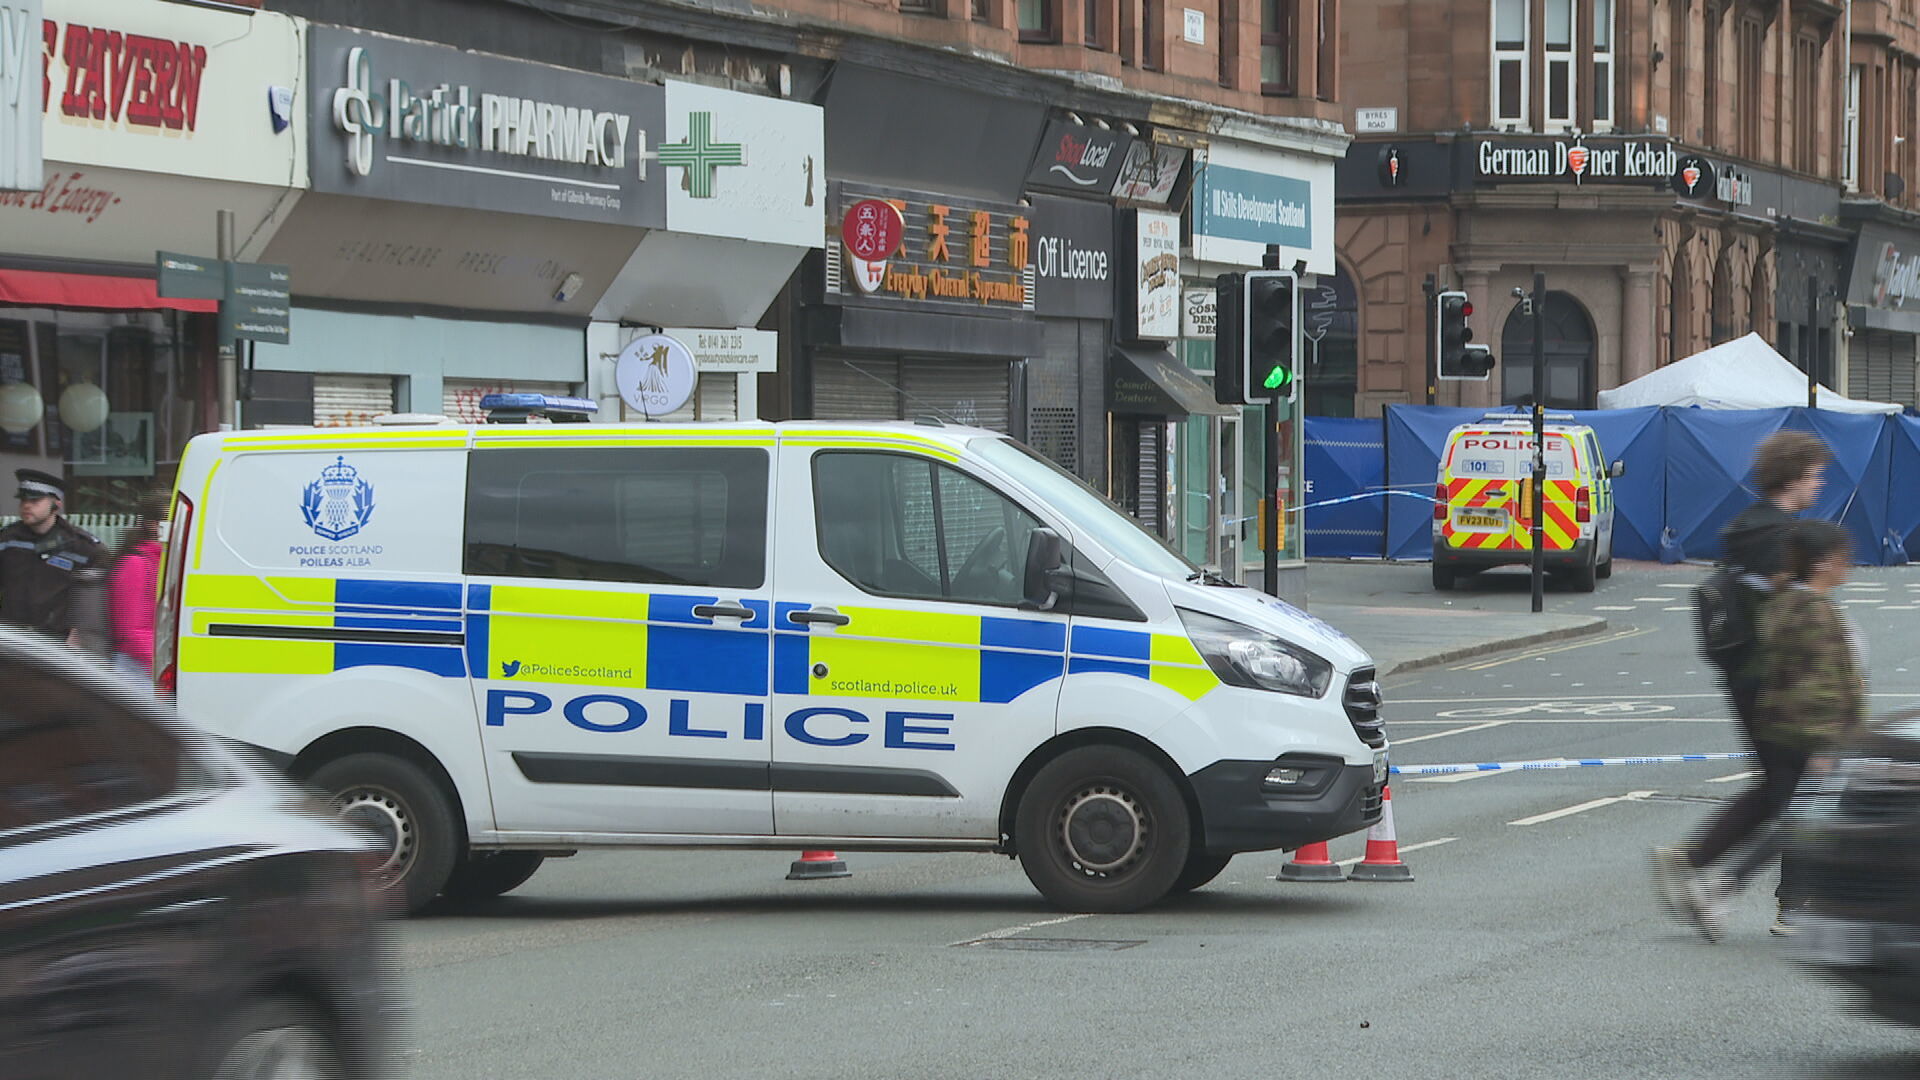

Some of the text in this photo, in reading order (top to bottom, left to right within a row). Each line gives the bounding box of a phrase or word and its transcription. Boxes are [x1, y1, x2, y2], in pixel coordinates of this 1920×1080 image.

[62, 23, 207, 132] TAVERN
[1366, 111, 1388, 119] BYRES
[481, 93, 630, 168] PHARMACY
[1368, 121, 1386, 129] ROAD
[1480, 141, 1549, 176] German
[1624, 141, 1677, 177] Kebab
[1220, 190, 1306, 228] Skills Development Scotland
[1038, 236, 1057, 277] Off
[1061, 239, 1108, 281] Licence
[1470, 461, 1487, 472] 101
[289, 545, 383, 555] POLICE SCOTLAND
[300, 558, 371, 567] POILEAS ALBA
[521, 663, 632, 679] @PoliceScotland
[831, 679, 957, 696] scotland.police.uk
[486, 689, 956, 751] POLICE
